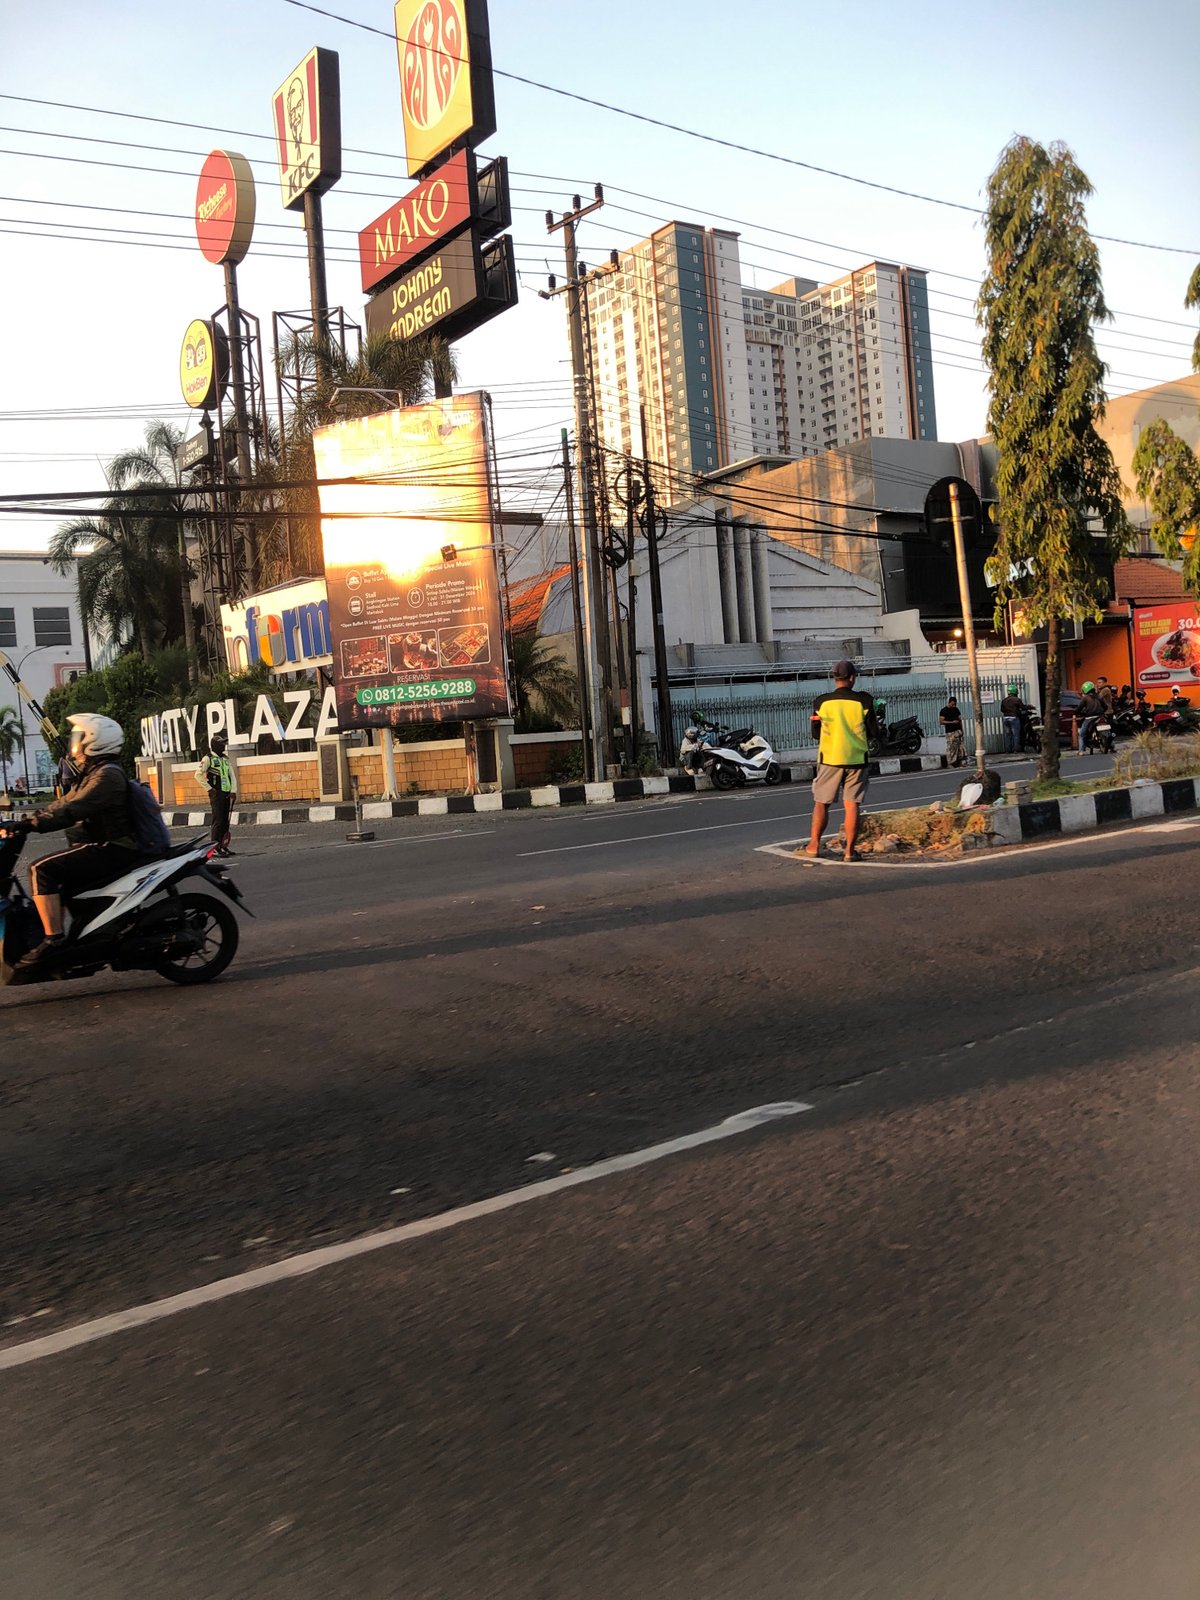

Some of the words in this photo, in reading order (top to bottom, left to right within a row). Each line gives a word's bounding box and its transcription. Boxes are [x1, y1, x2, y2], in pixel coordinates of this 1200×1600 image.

[288, 152, 315, 200] KFC
[198, 183, 228, 223] Richeese
[375, 179, 450, 269] MAKO
[185, 376, 208, 396] HokBen
[426, 582, 446, 590] Periode
[375, 681, 473, 701] 0812-5256-9288
[396, 674, 431, 683] RESERVASI
[206, 687, 339, 750] PLAZA
